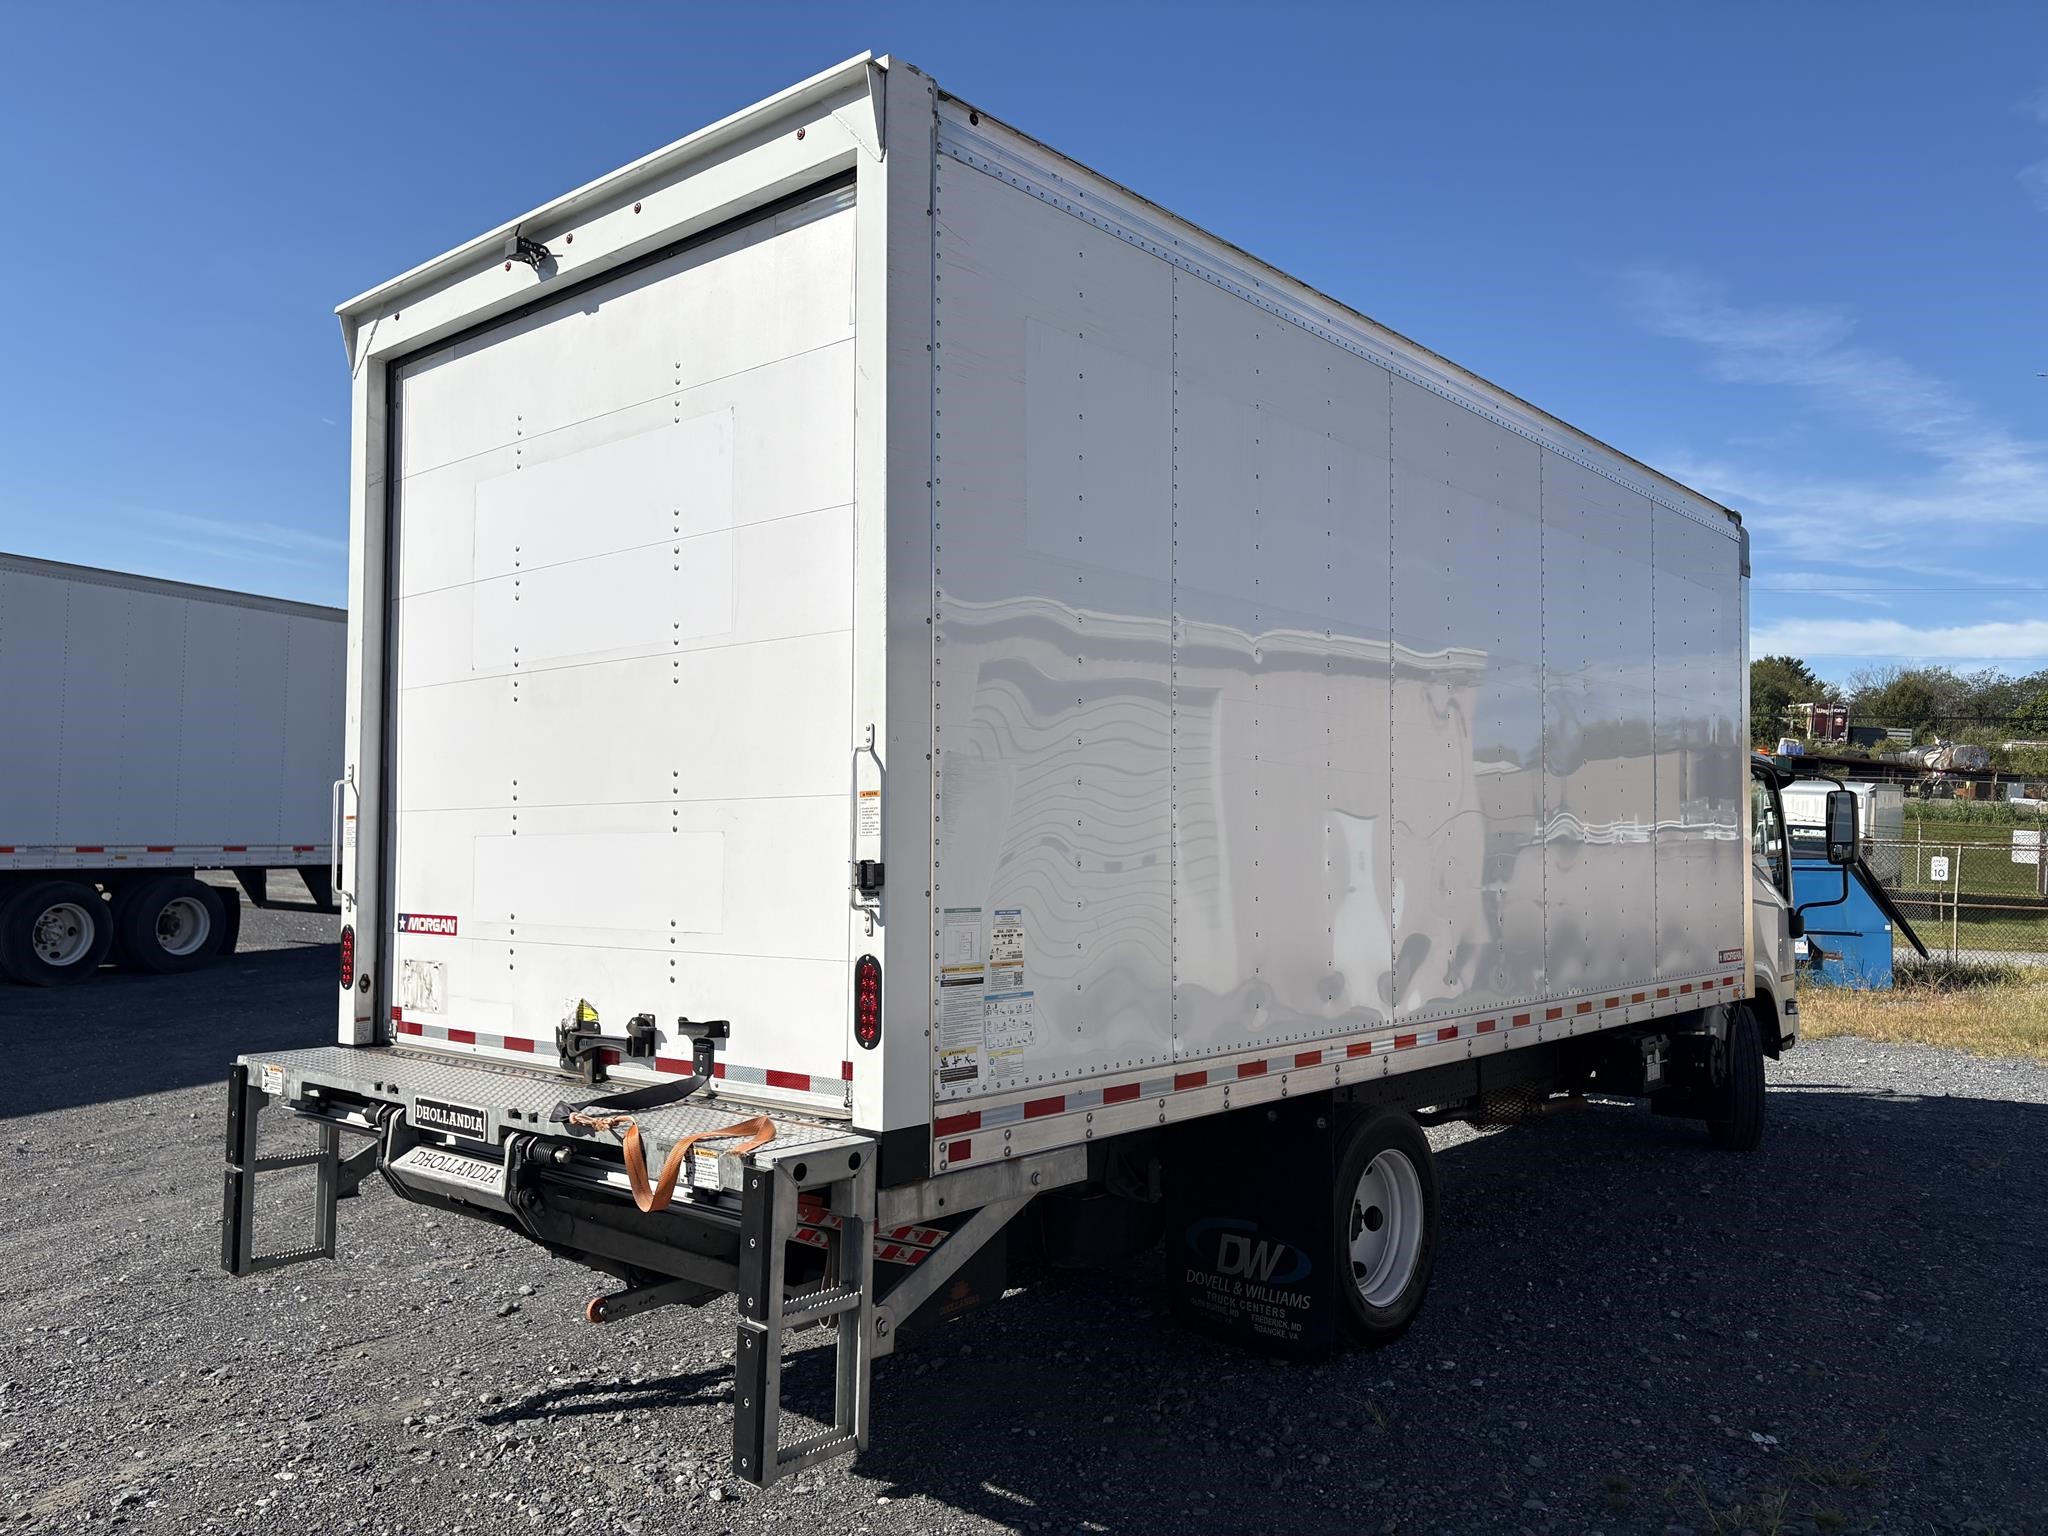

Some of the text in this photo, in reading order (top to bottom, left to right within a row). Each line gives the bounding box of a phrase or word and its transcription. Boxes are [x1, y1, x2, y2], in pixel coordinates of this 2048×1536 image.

[1934, 868, 1945, 878] 10
[408, 916, 456, 934] MORGAN
[416, 1104, 484, 1132] DHOLLANDIA
[410, 1151, 502, 1184] DHOLLANDIA
[1216, 1232, 1286, 1282] DW
[1186, 1269, 1312, 1310] DOVELL & WILLIAMS
[1206, 1290, 1237, 1307] TRUCK
[1239, 1300, 1286, 1319] CENTERS
[1289, 1331, 1300, 1341] VA
[1291, 1322, 1302, 1332] MD
